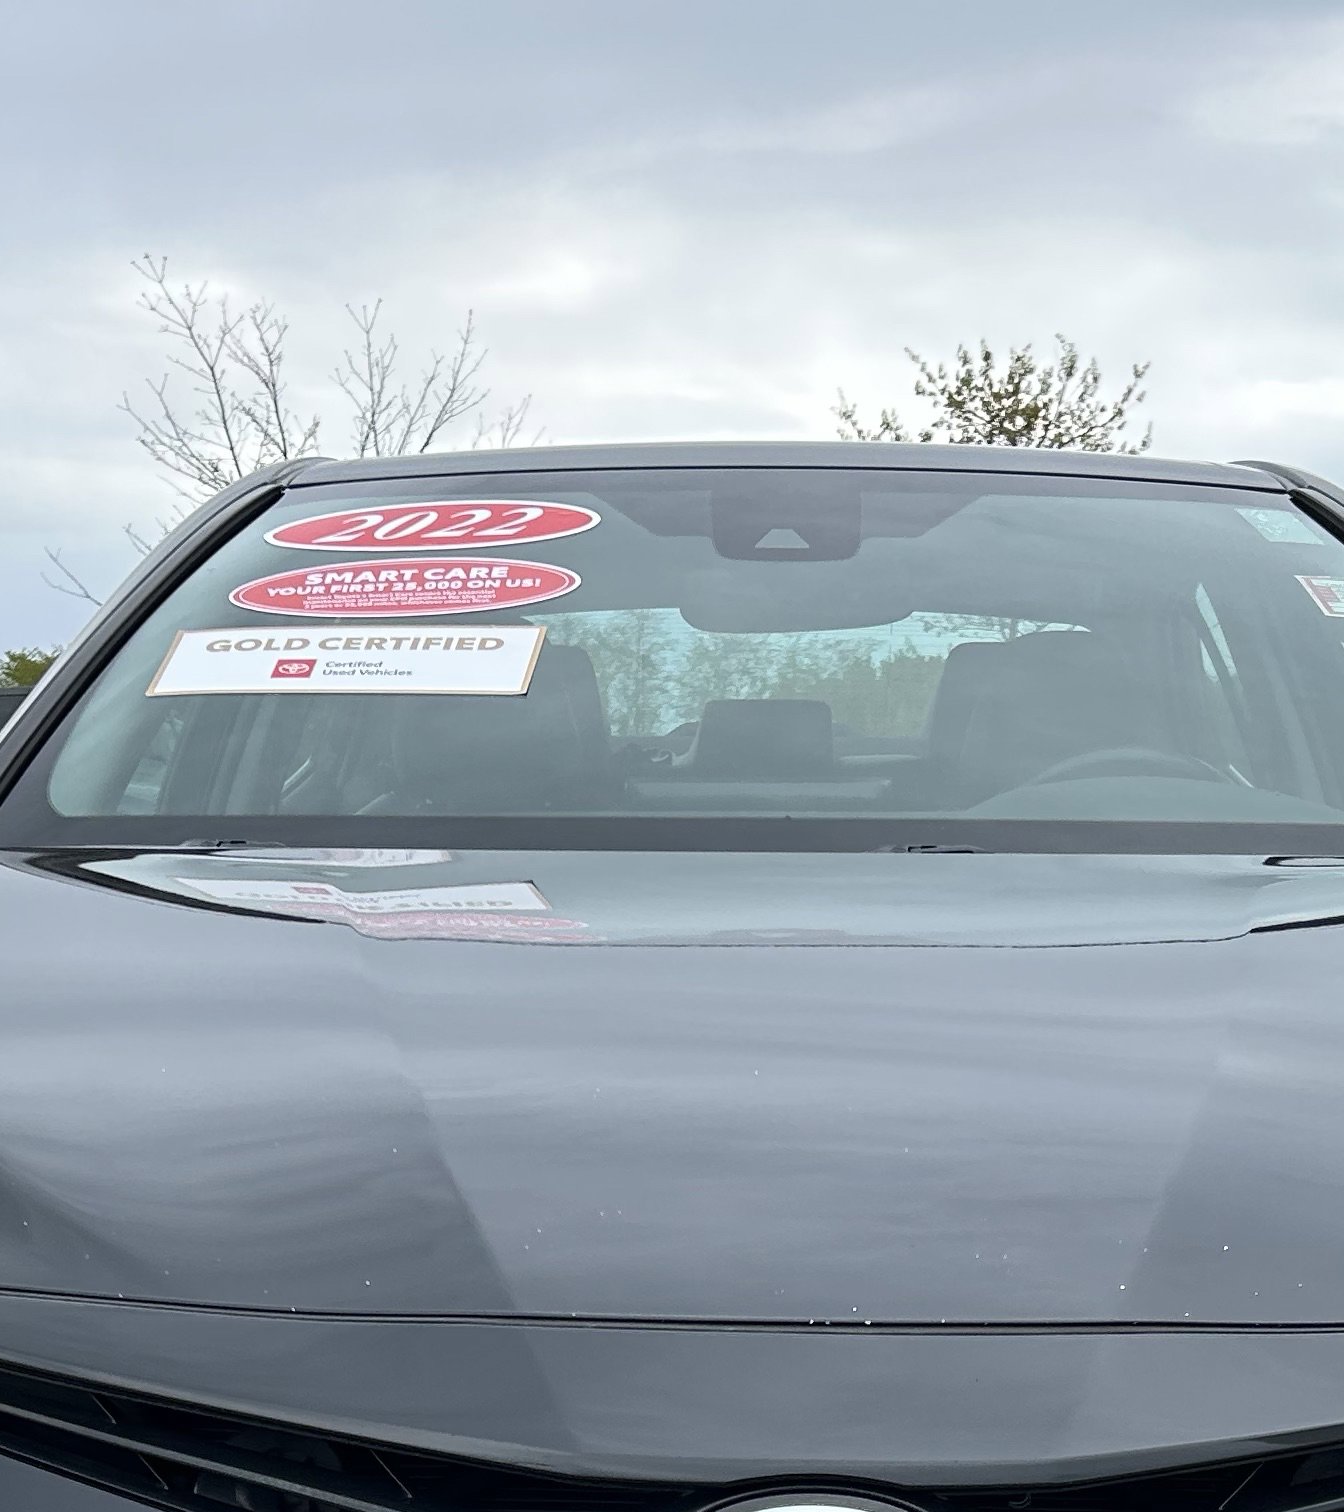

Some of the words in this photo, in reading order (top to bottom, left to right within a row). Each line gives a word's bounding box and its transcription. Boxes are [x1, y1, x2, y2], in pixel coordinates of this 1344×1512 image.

[311, 506, 544, 544] 2022
[305, 569, 420, 585] SMART
[423, 566, 509, 580] CARE
[266, 585, 325, 597] YOUR
[330, 582, 389, 594] FIRST
[466, 579, 501, 589] ON
[506, 578, 541, 588] US!
[205, 637, 311, 653] GOLD
[317, 636, 505, 652] CERTIFIED
[322, 668, 356, 676] Used
[359, 668, 414, 676] Vehicles
[325, 660, 384, 669] Certified
